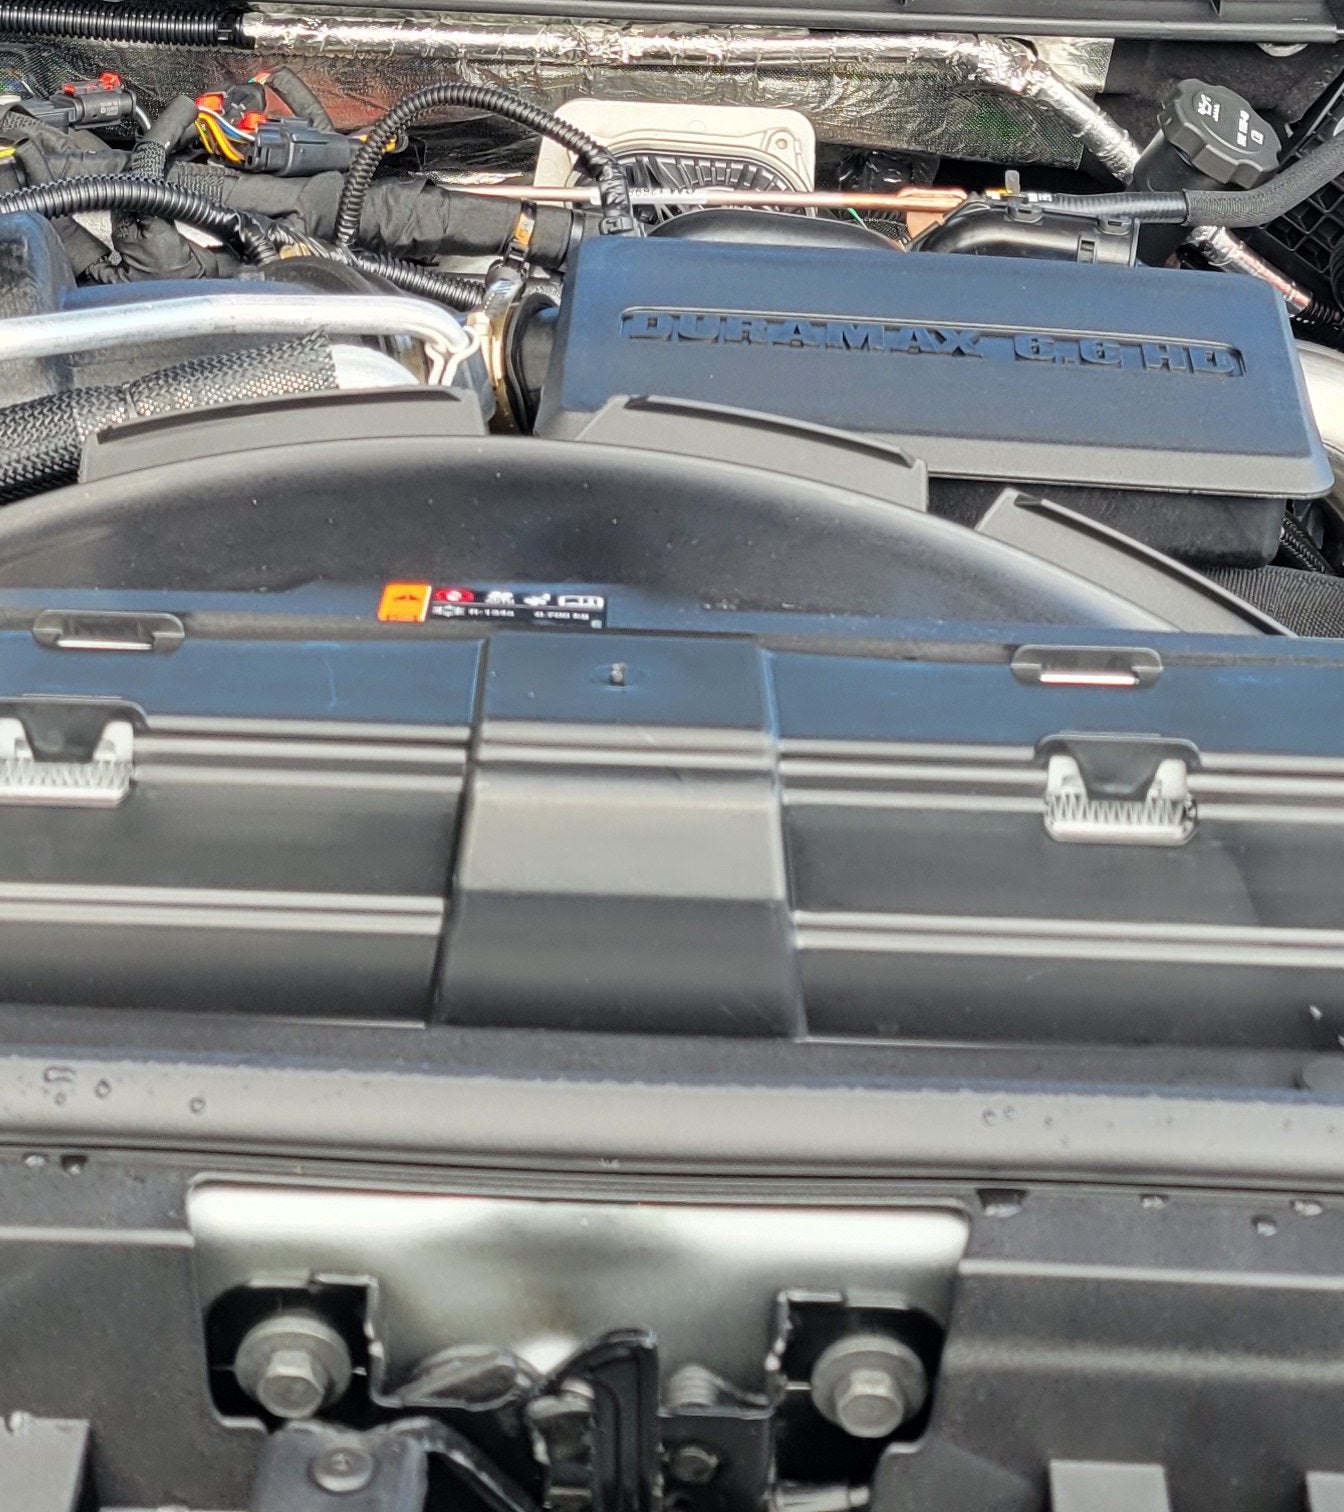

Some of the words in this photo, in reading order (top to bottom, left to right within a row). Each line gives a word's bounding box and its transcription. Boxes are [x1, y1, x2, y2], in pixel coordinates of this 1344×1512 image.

[629, 312, 983, 358] DURAMAX
[1014, 334, 1123, 365] 6.6
[1141, 343, 1235, 375] HD
